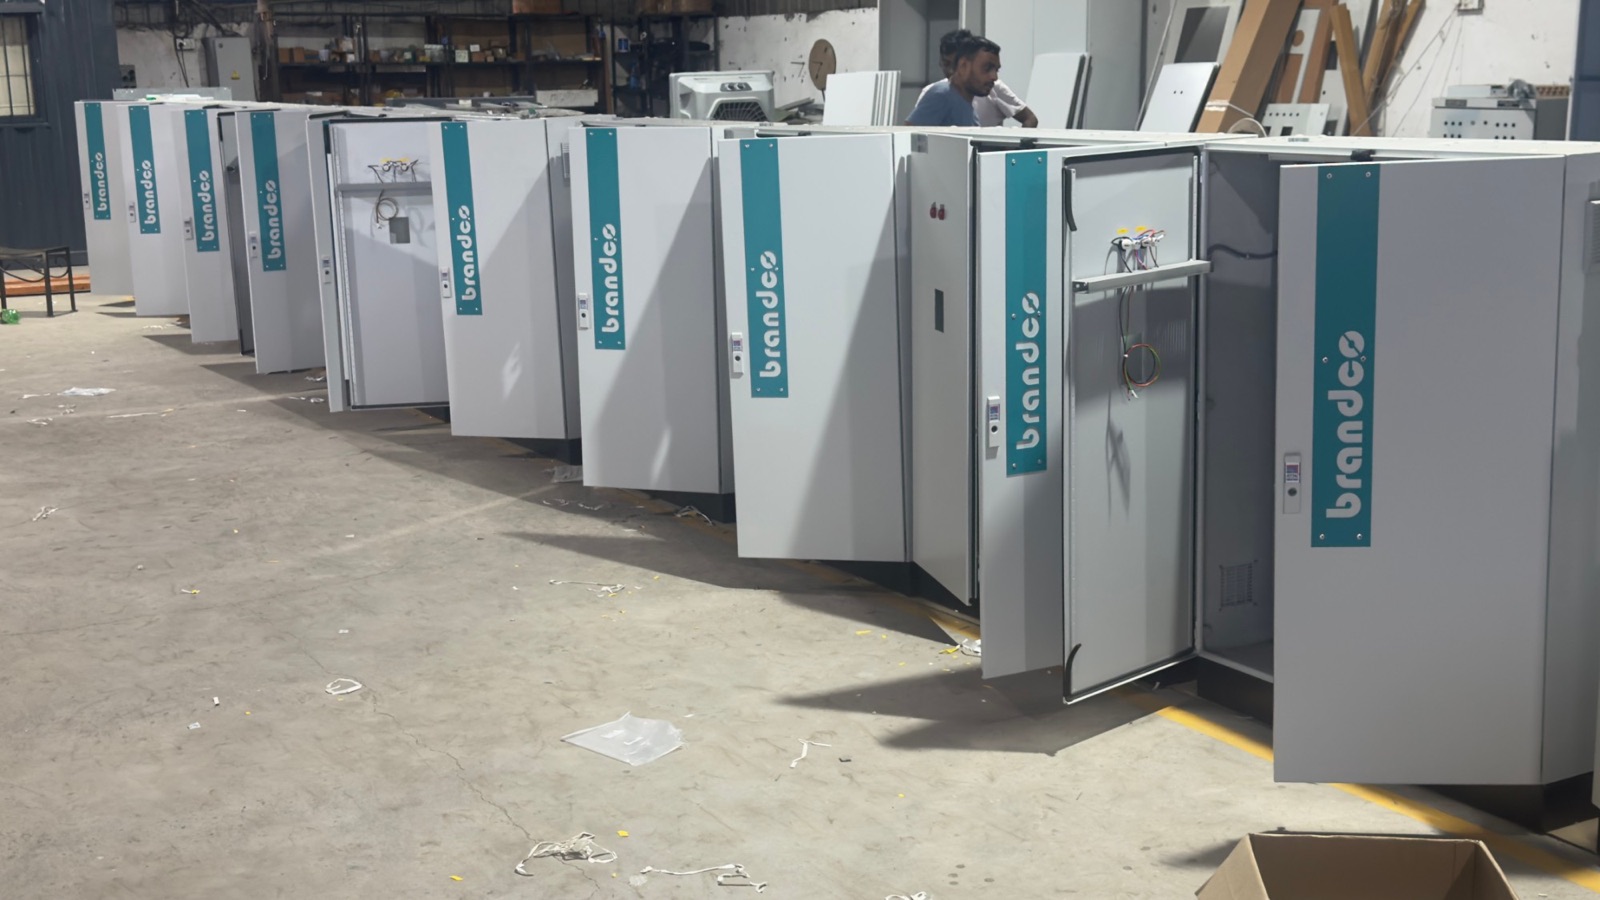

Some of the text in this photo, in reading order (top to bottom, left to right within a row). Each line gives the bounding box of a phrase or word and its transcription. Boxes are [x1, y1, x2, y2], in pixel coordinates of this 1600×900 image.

[94, 151, 107, 212] brandco
[140, 160, 157, 225] brandco
[198, 170, 216, 242] brandco
[264, 180, 282, 260] brandco
[457, 204, 477, 301] brandco
[598, 223, 620, 333] brandco
[755, 251, 782, 378] brandco
[1016, 292, 1041, 450] brandco
[1326, 331, 1365, 519] brandco
